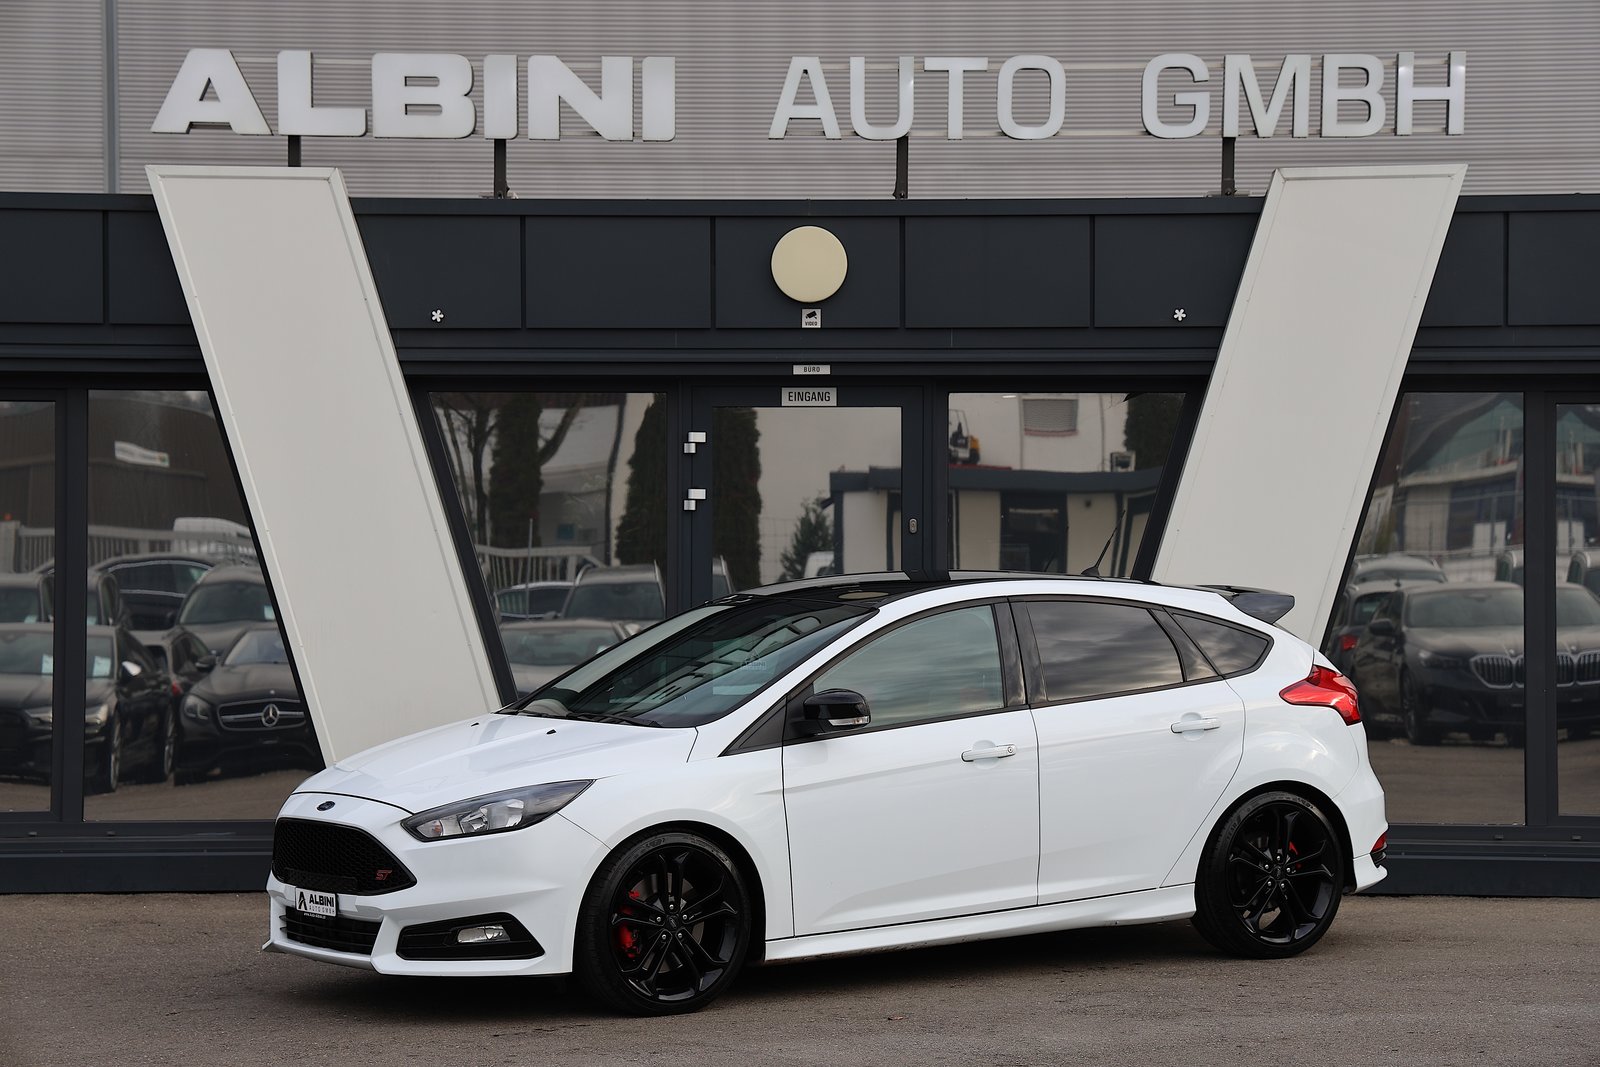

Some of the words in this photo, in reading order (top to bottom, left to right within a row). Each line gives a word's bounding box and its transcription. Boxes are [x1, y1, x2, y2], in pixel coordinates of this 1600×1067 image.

[150, 48, 677, 142] ALBINI
[768, 54, 1066, 141] AUTO
[1141, 49, 1467, 139] GMBH
[803, 365, 820, 373] BÜRO
[788, 391, 831, 402] EINGANG
[375, 869, 392, 880] ST
[309, 893, 334, 907] ALBINI
